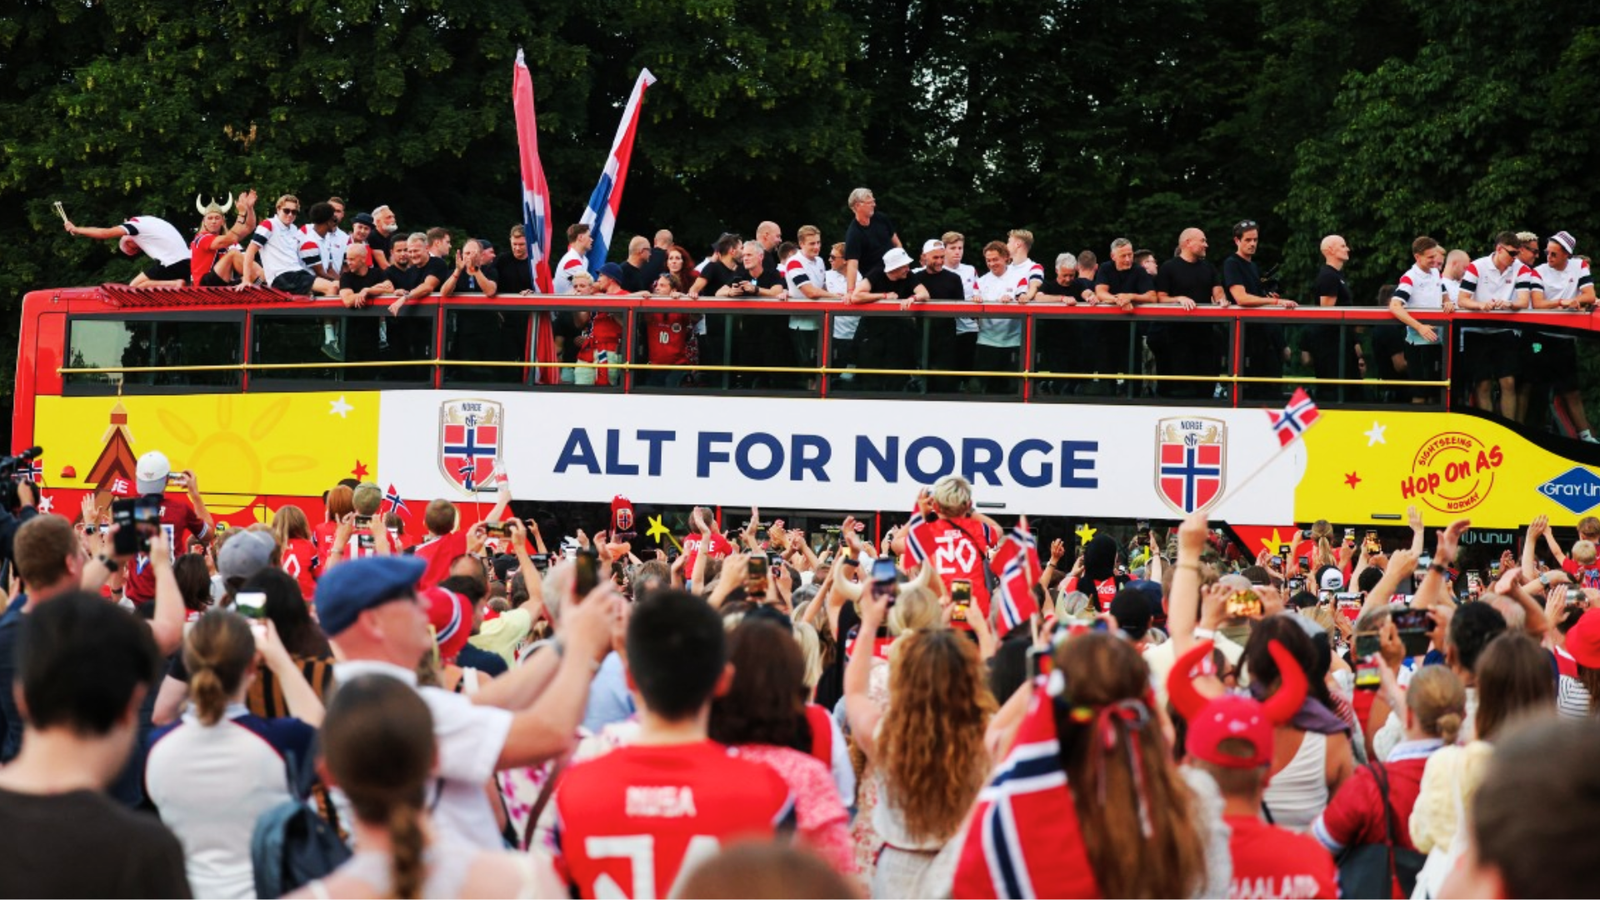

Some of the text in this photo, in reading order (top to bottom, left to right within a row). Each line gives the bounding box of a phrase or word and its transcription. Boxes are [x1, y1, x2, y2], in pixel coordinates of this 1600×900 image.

[461, 403, 482, 412] NORGE
[1181, 420, 1203, 430] NORGE
[553, 427, 1099, 489] ALT FOR NORGE
[1418, 436, 1473, 467] SIGHTSEEING
[1401, 445, 1504, 500] Hop On AS
[1446, 491, 1480, 510] NORWAY
[1543, 482, 1582, 496] Gray
[934, 537, 977, 575] 20
